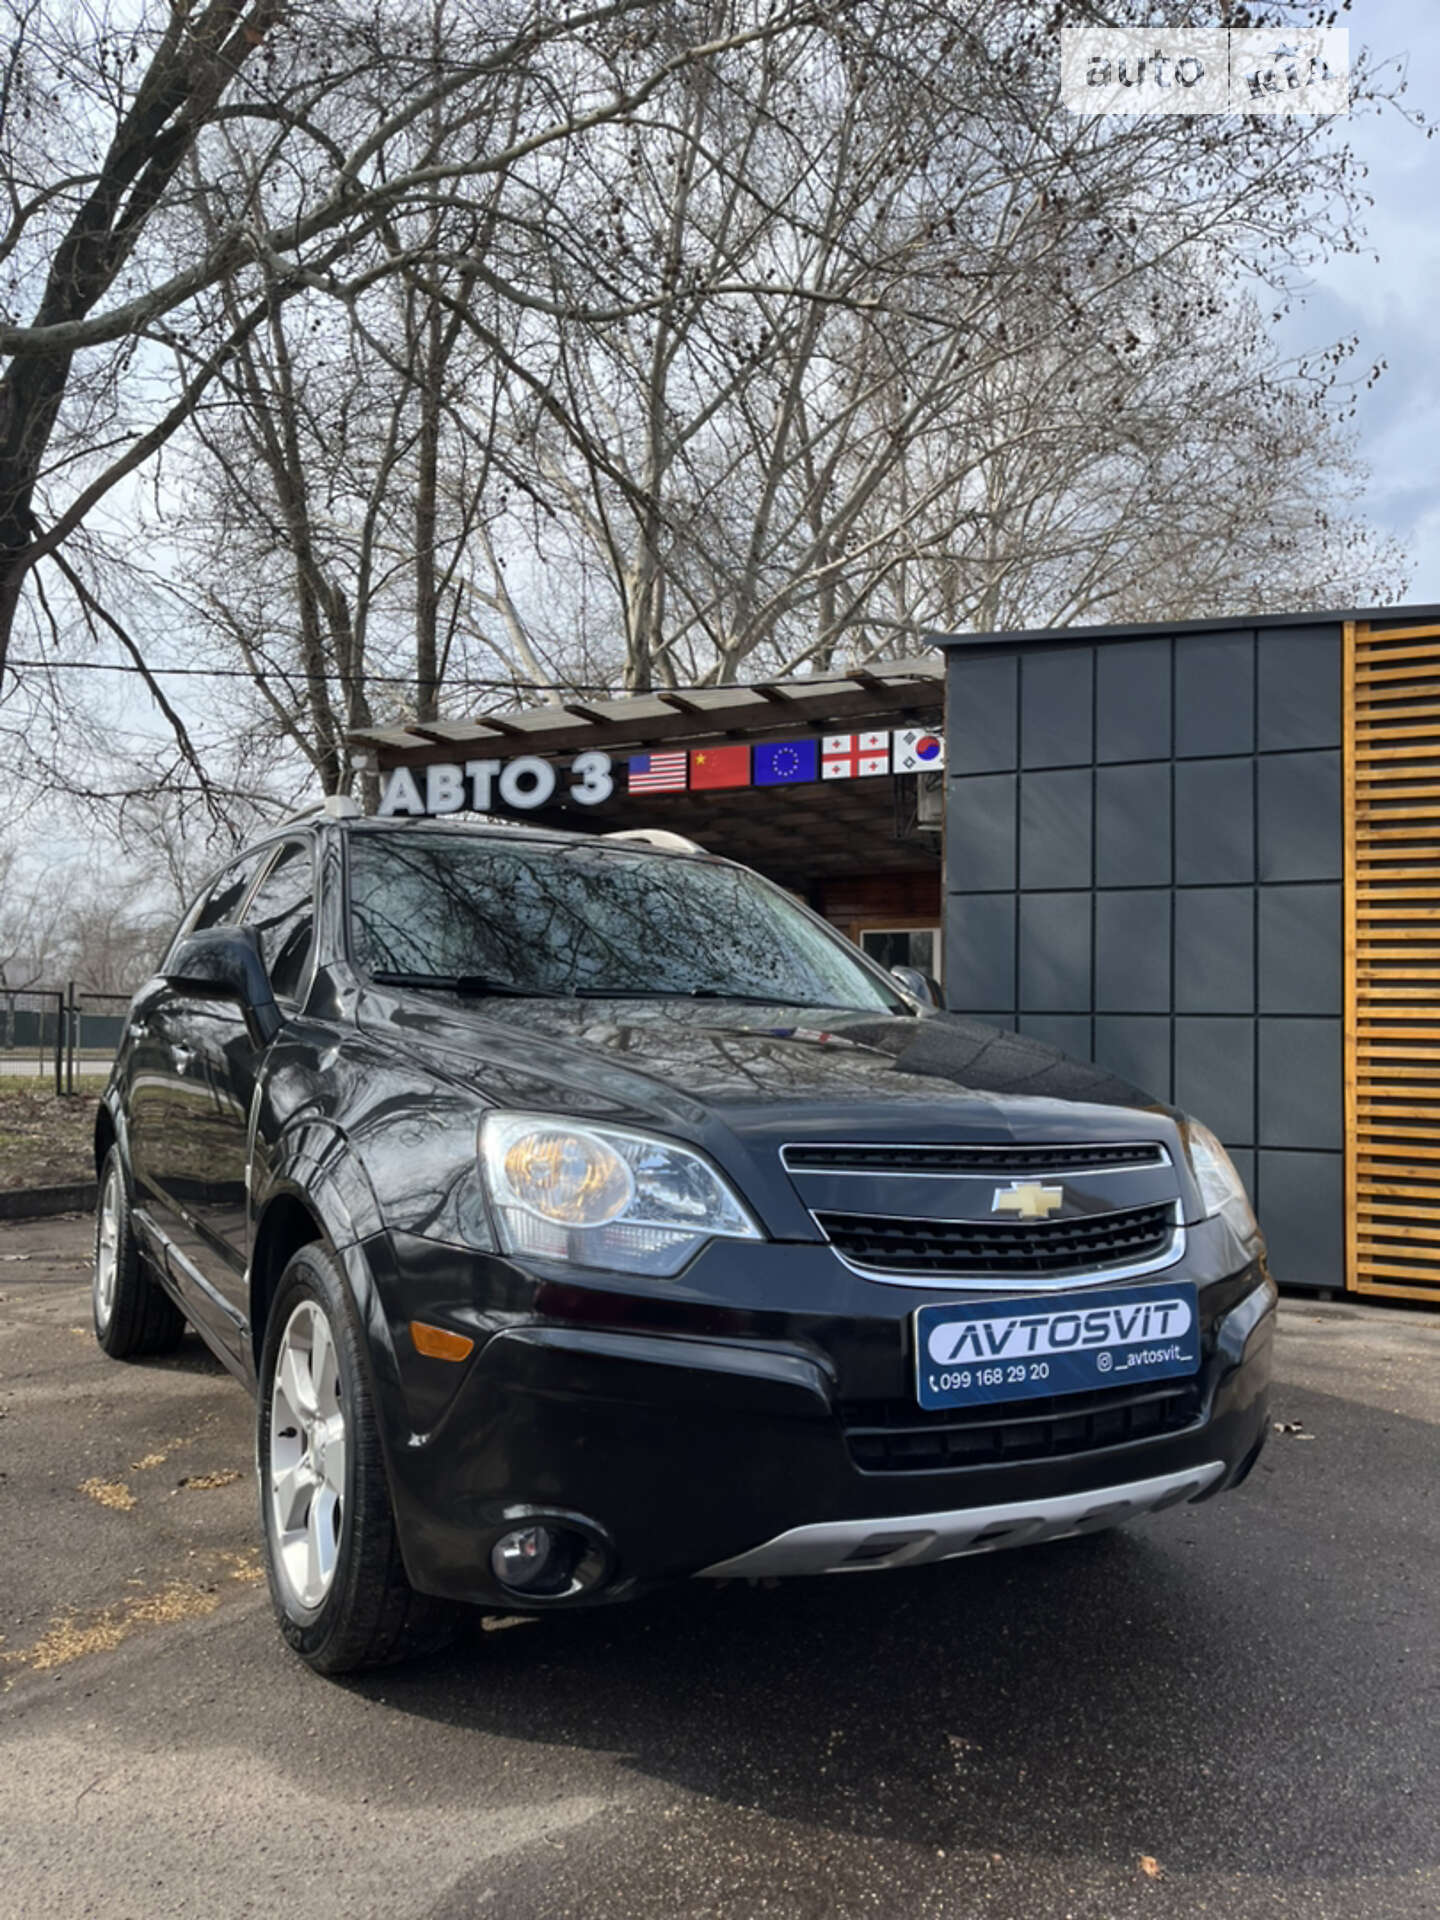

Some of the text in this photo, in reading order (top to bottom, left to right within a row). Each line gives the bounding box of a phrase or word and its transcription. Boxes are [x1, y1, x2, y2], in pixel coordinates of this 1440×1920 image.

[378, 755, 556, 817] АВТО
[946, 1303, 1180, 1361] AVTOSVIT
[940, 1362, 1050, 1391] 099 168 29 20
